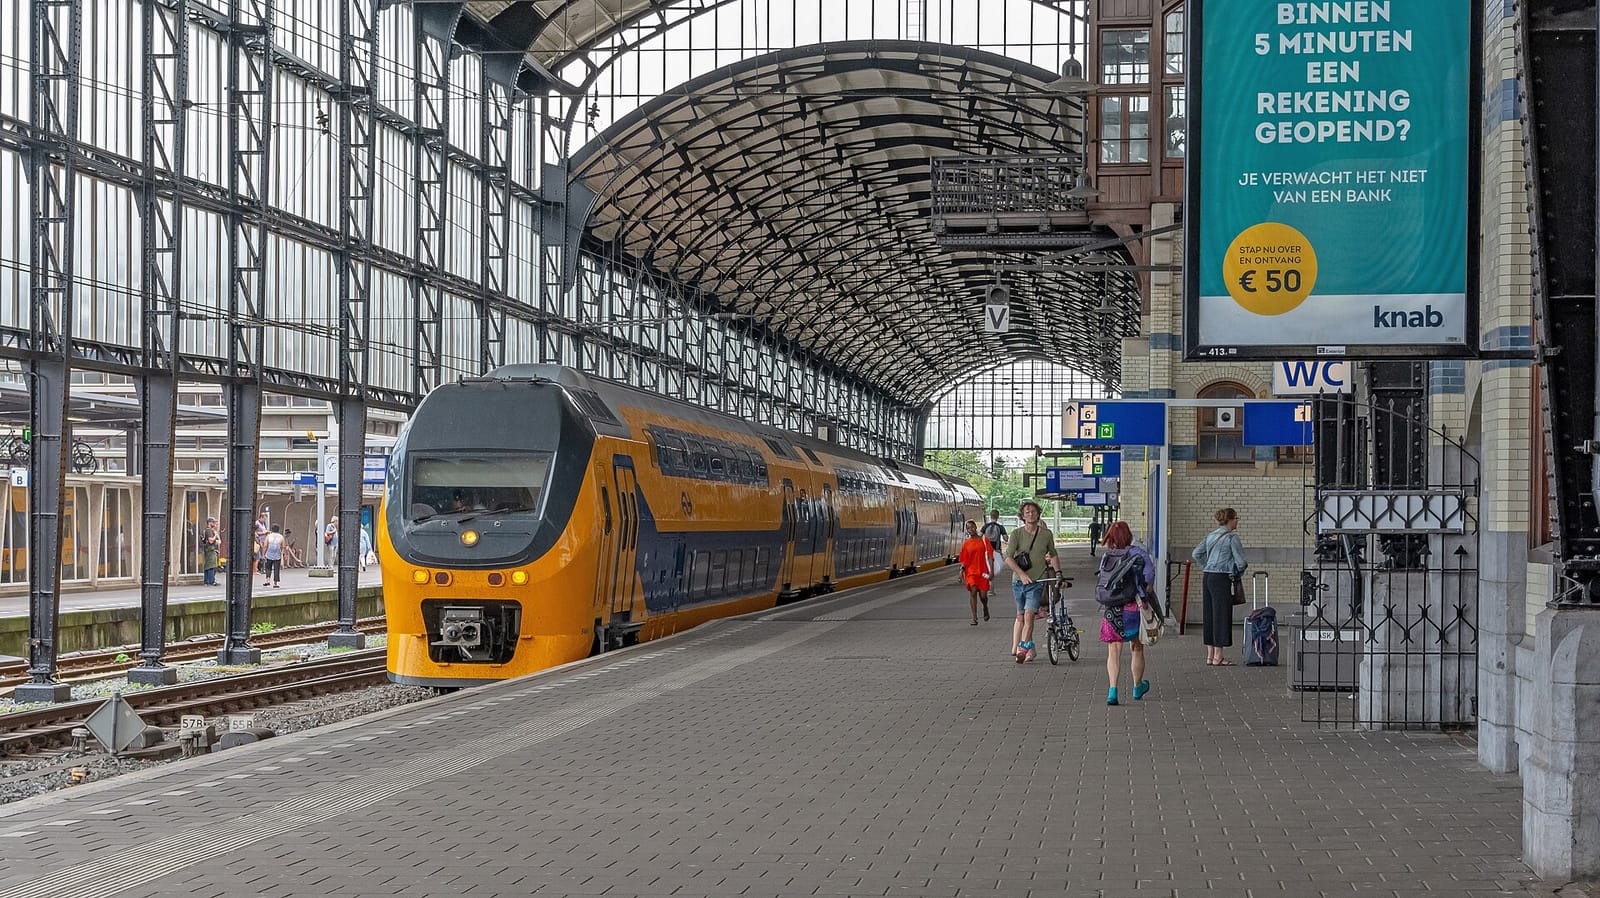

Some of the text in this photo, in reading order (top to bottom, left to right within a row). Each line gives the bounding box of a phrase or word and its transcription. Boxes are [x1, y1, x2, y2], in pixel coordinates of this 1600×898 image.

[1277, 1, 1390, 25] BINNEN
[1255, 30, 1412, 55] 5 MINUTEN
[1307, 61, 1360, 83] EEN
[1257, 90, 1410, 114] REKENING
[1255, 119, 1411, 144] GEOPEND?
[1239, 169, 1428, 186] JE VERWACHT HET NIET
[1273, 188, 1391, 203] VAN EEN BANK
[1239, 245, 1302, 254] STAP NU OVER
[1239, 256, 1302, 265] EN ONTVANG
[1238, 269, 1301, 293] € 50
[988, 307, 1008, 330] V
[1282, 361, 1344, 387] WC
[16, 475, 23, 485] B
